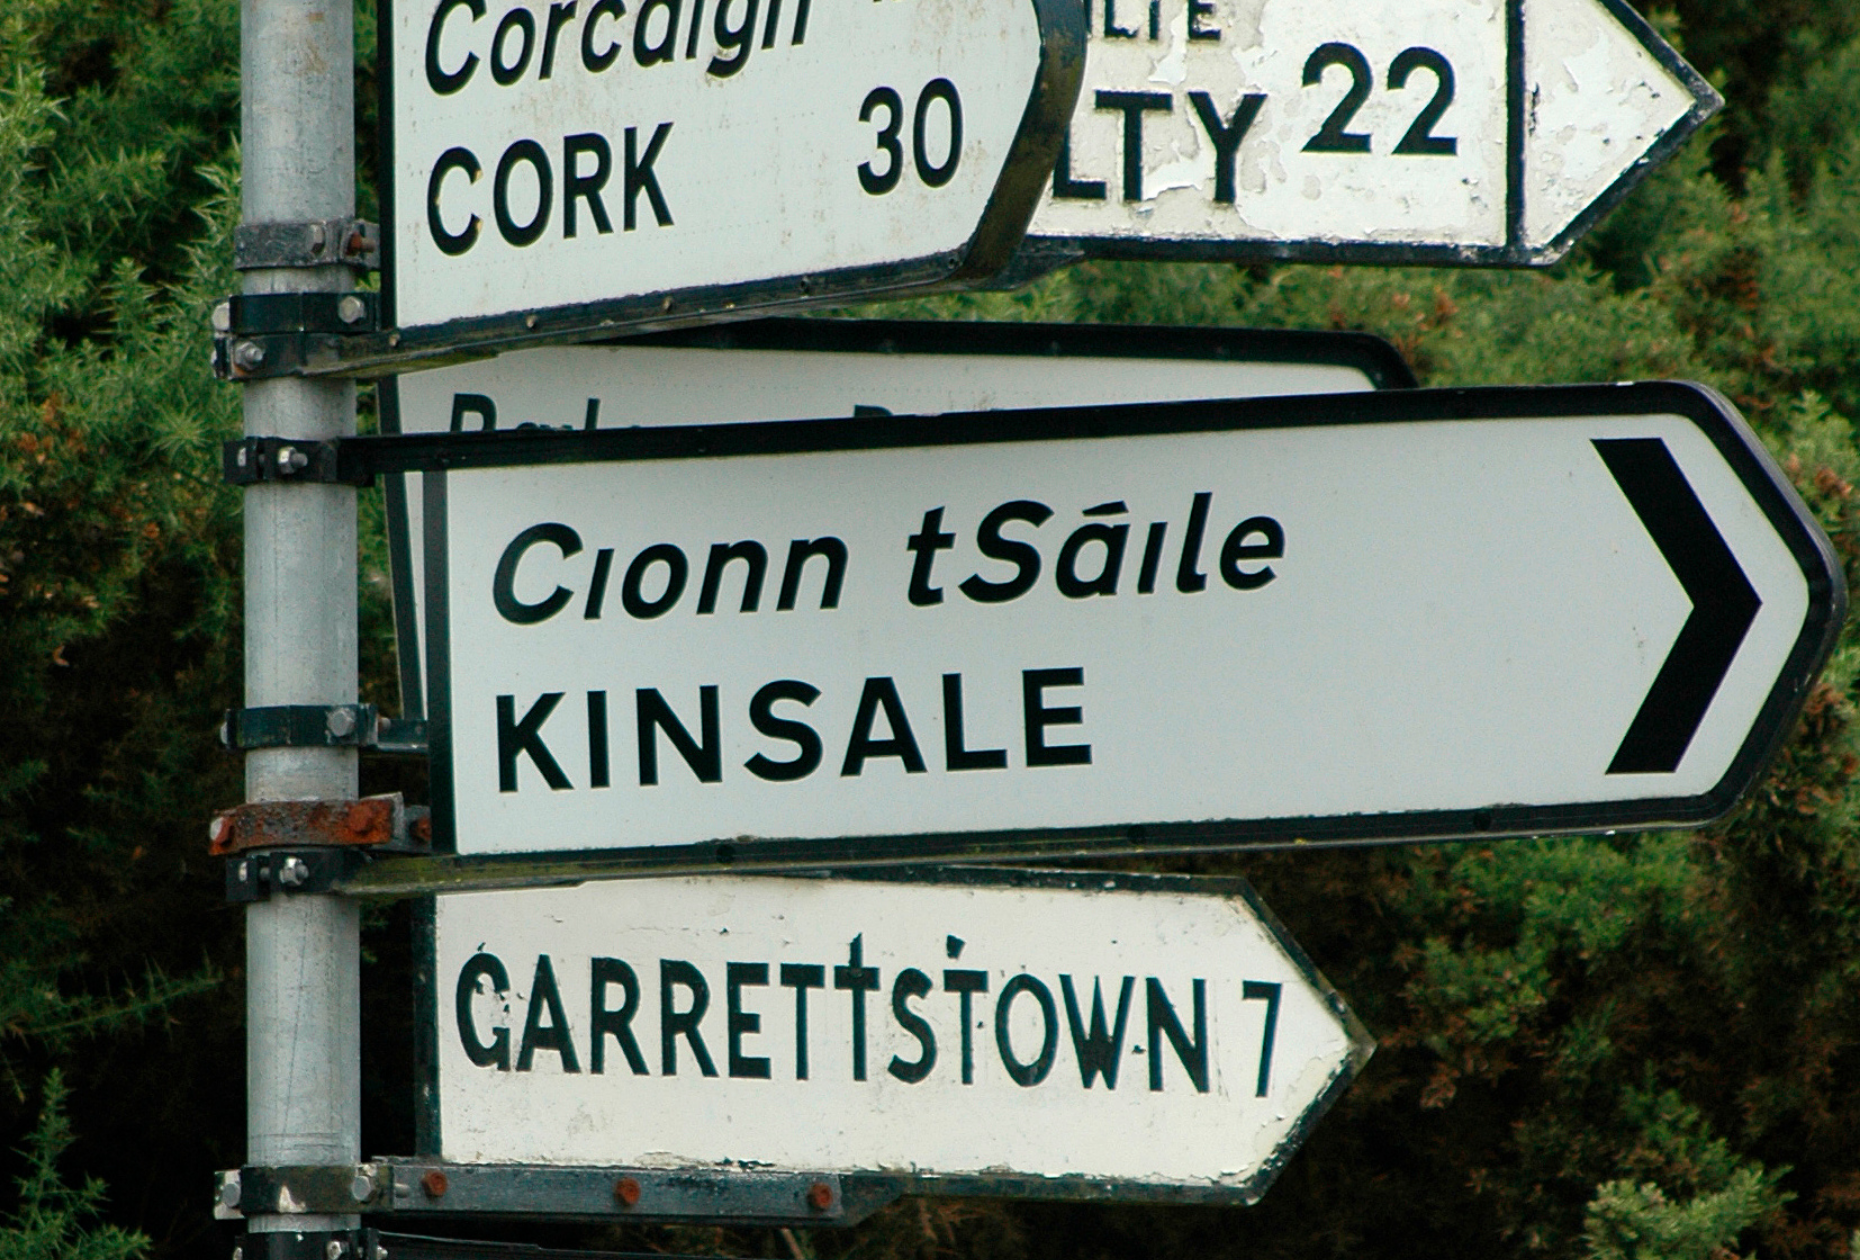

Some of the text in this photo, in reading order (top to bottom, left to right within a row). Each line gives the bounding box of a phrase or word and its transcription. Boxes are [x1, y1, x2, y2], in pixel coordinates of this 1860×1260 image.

[1301, 42, 1458, 156] 22
[426, 77, 964, 257] CORK 30
[495, 666, 1094, 794] KINSALE
[1242, 980, 1283, 1098] 7
